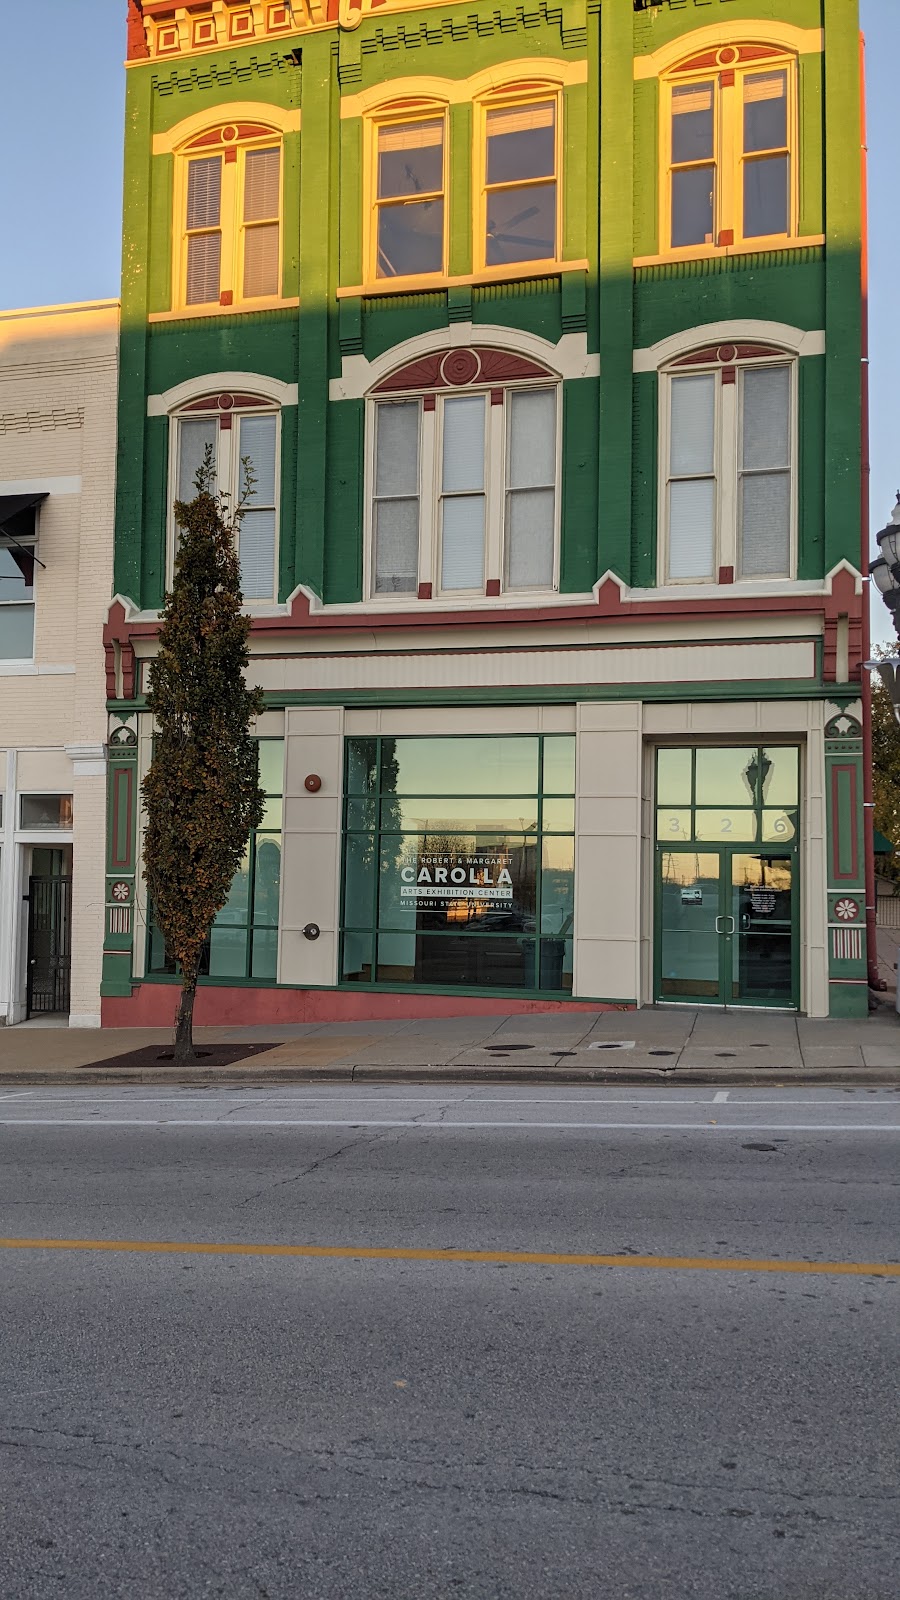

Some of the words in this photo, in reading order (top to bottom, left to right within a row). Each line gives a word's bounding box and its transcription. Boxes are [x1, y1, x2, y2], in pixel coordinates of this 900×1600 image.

[669, 817, 680, 833] 3
[720, 818, 733, 833] 2
[773, 818, 786, 833] 6
[401, 866, 513, 884] CAROLLA
[426, 888, 474, 896] EXHIBITION
